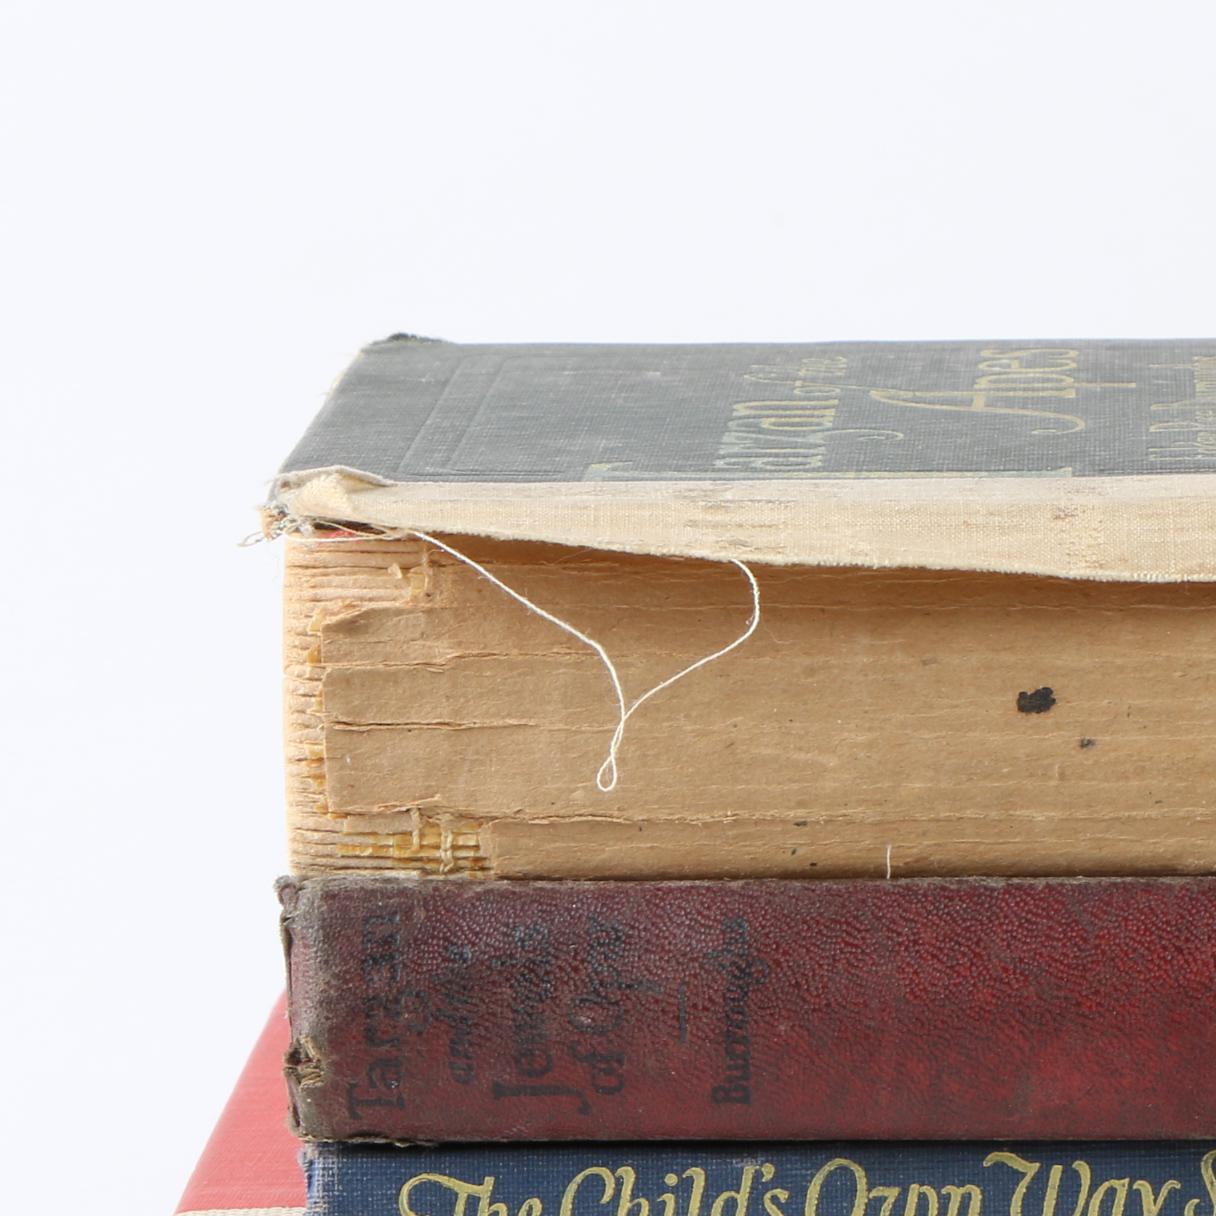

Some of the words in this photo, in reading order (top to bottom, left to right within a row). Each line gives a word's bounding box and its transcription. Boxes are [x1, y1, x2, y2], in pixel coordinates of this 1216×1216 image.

[870, 346, 1136, 435] Apes
[347, 912, 432, 1121] Tarzan
[568, 1037, 626, 1096] of
